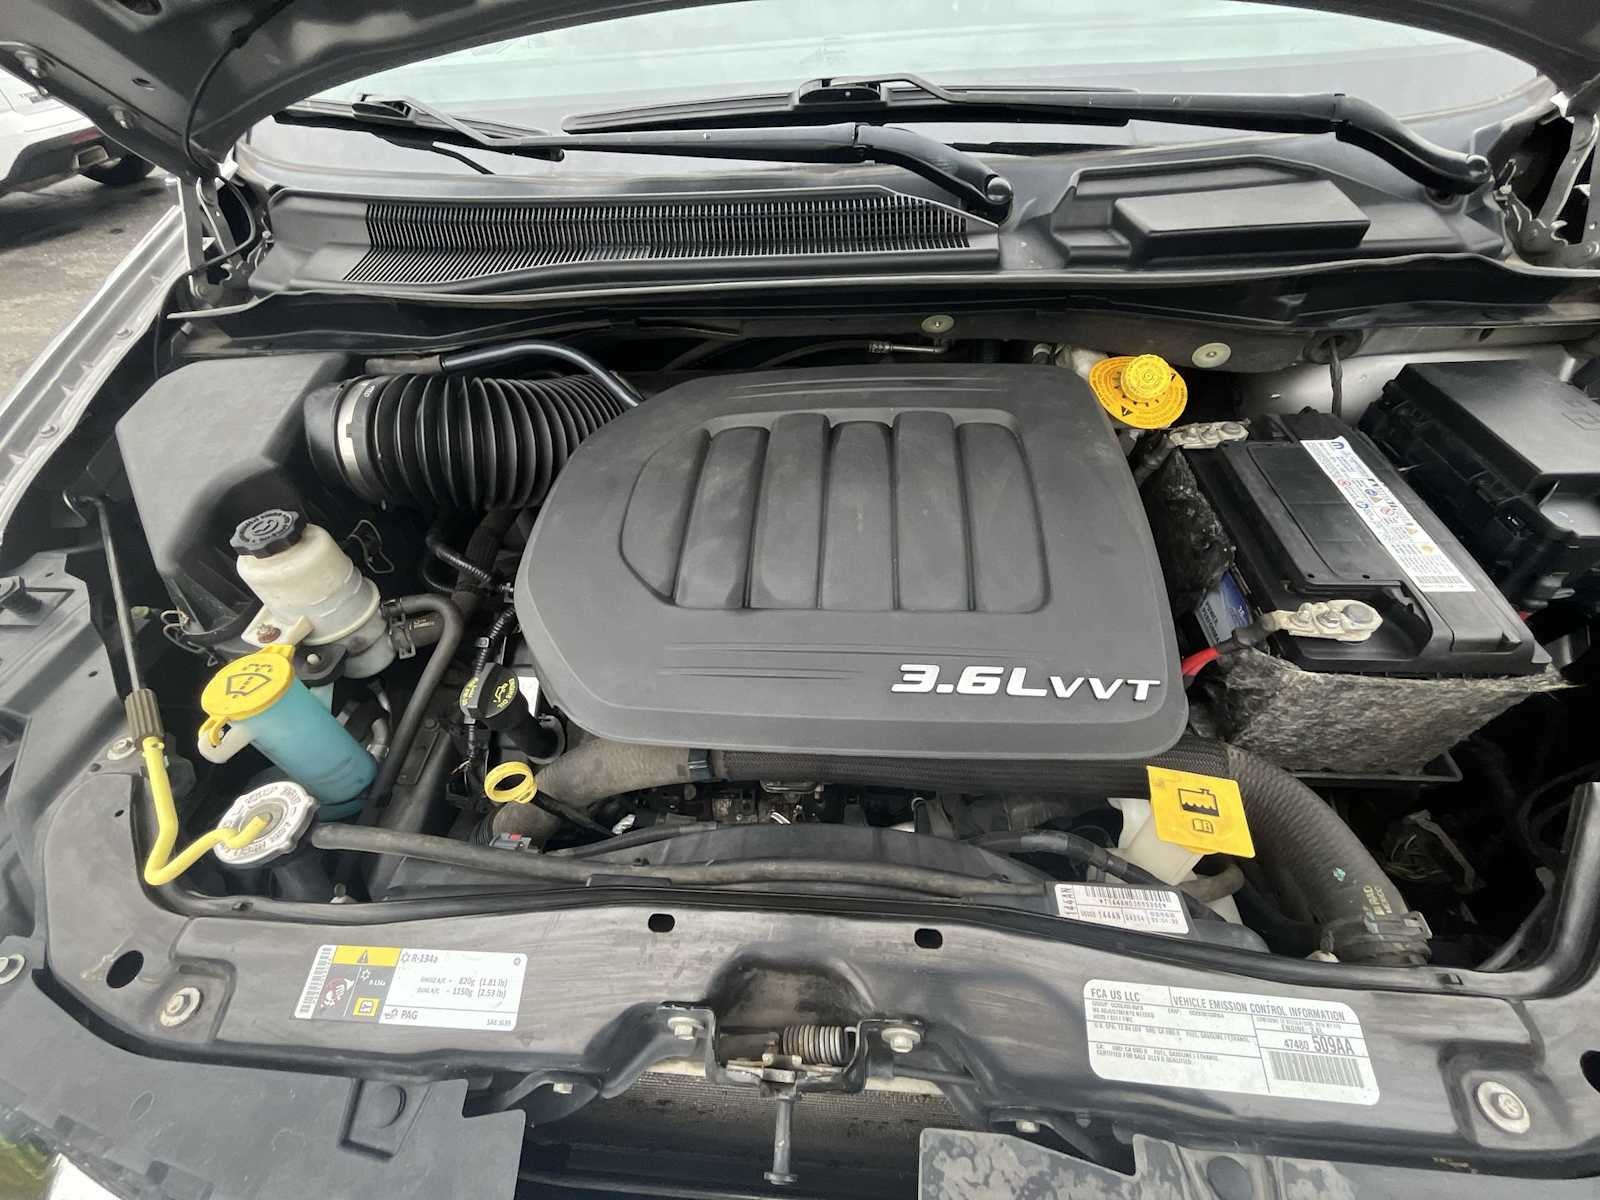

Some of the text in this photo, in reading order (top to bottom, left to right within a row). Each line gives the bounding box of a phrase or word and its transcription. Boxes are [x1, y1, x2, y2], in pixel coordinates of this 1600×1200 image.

[891, 663, 1161, 701] 3.6L VVT
[496, 677, 516, 709] ENGINE OIL
[411, 953, 439, 964] R-134a
[1091, 988, 1140, 1002] FCA US LLC
[400, 1009, 418, 1021] PAG
[1173, 995, 1345, 1021] VEHICLE EMISSION CONTROL INFORMATION
[1312, 1036, 1355, 1056] 509AA
